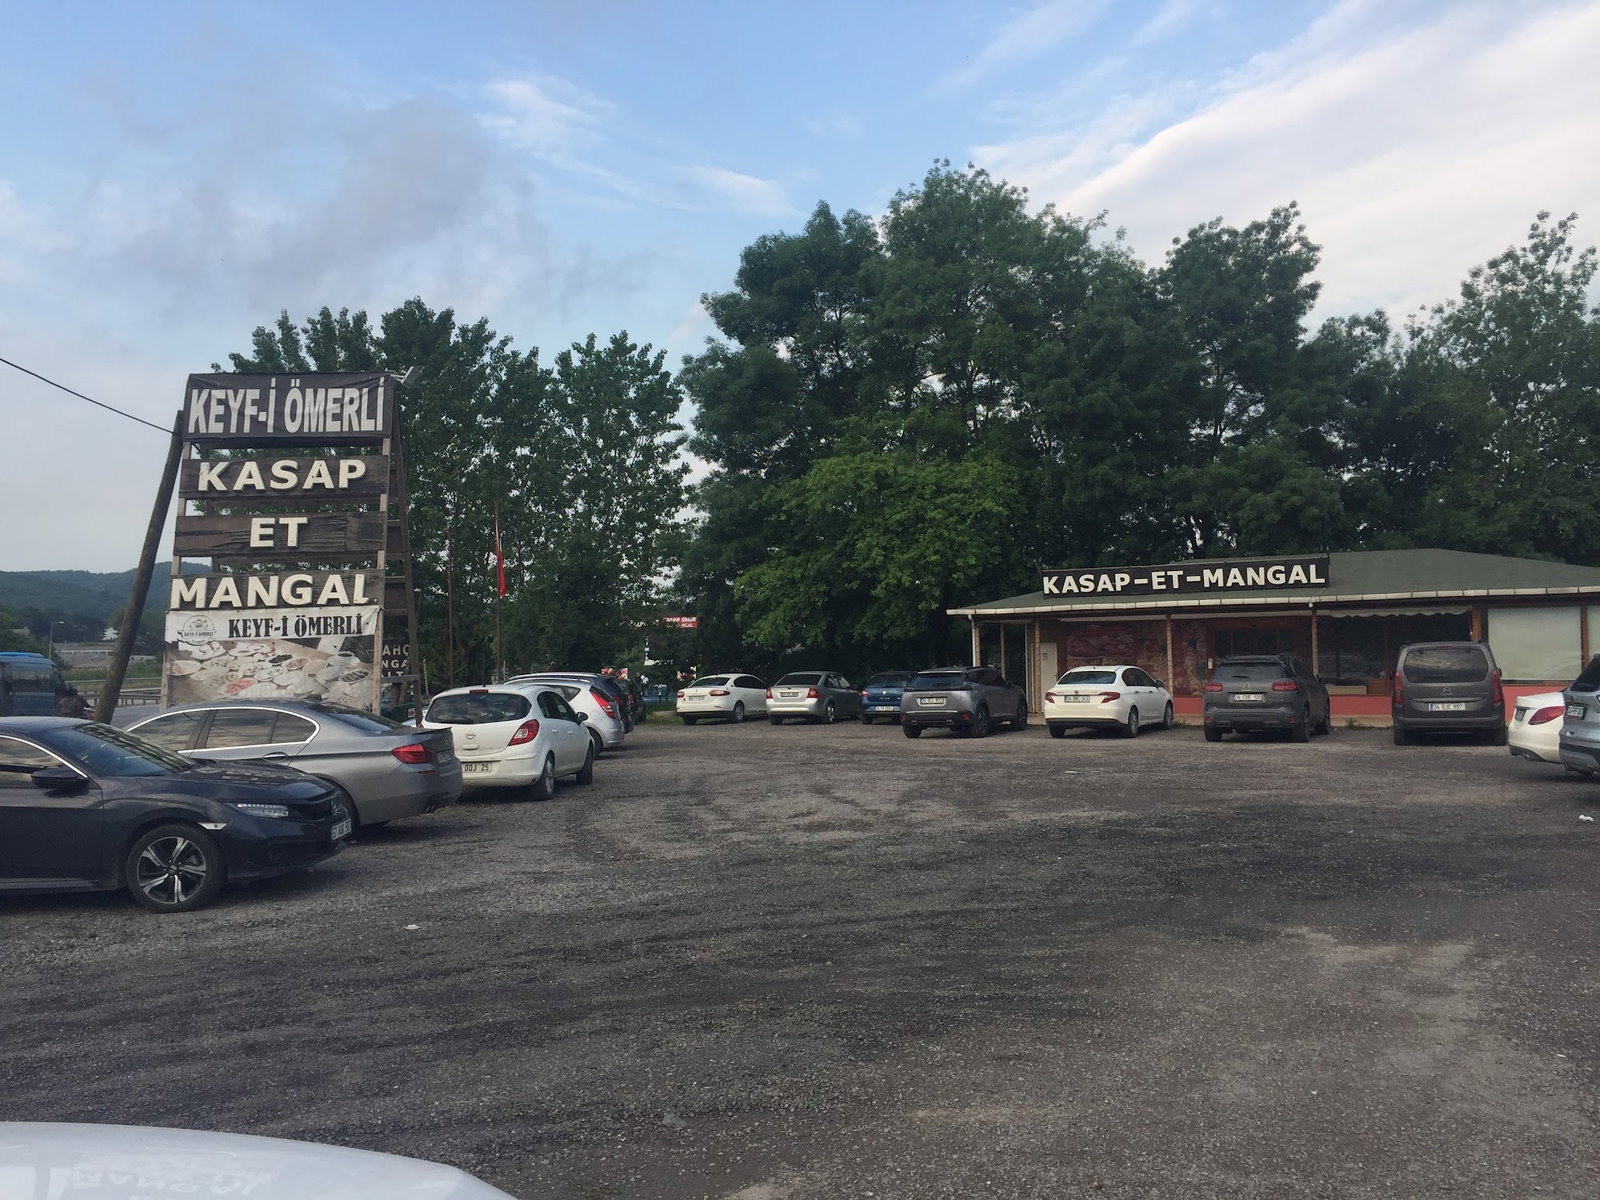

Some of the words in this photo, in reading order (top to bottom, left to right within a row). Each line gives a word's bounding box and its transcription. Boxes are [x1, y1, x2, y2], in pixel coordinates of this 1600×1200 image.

[188, 377, 276, 433] KEYF-İ
[284, 376, 385, 433] ÖMERLİ
[197, 459, 366, 491] KASAP
[249, 517, 308, 548] ET
[169, 573, 371, 609] MANGAL
[228, 615, 288, 638] KEYF-İ
[294, 612, 363, 637] ÖMERLİ
[481, 763, 489, 772] 25
